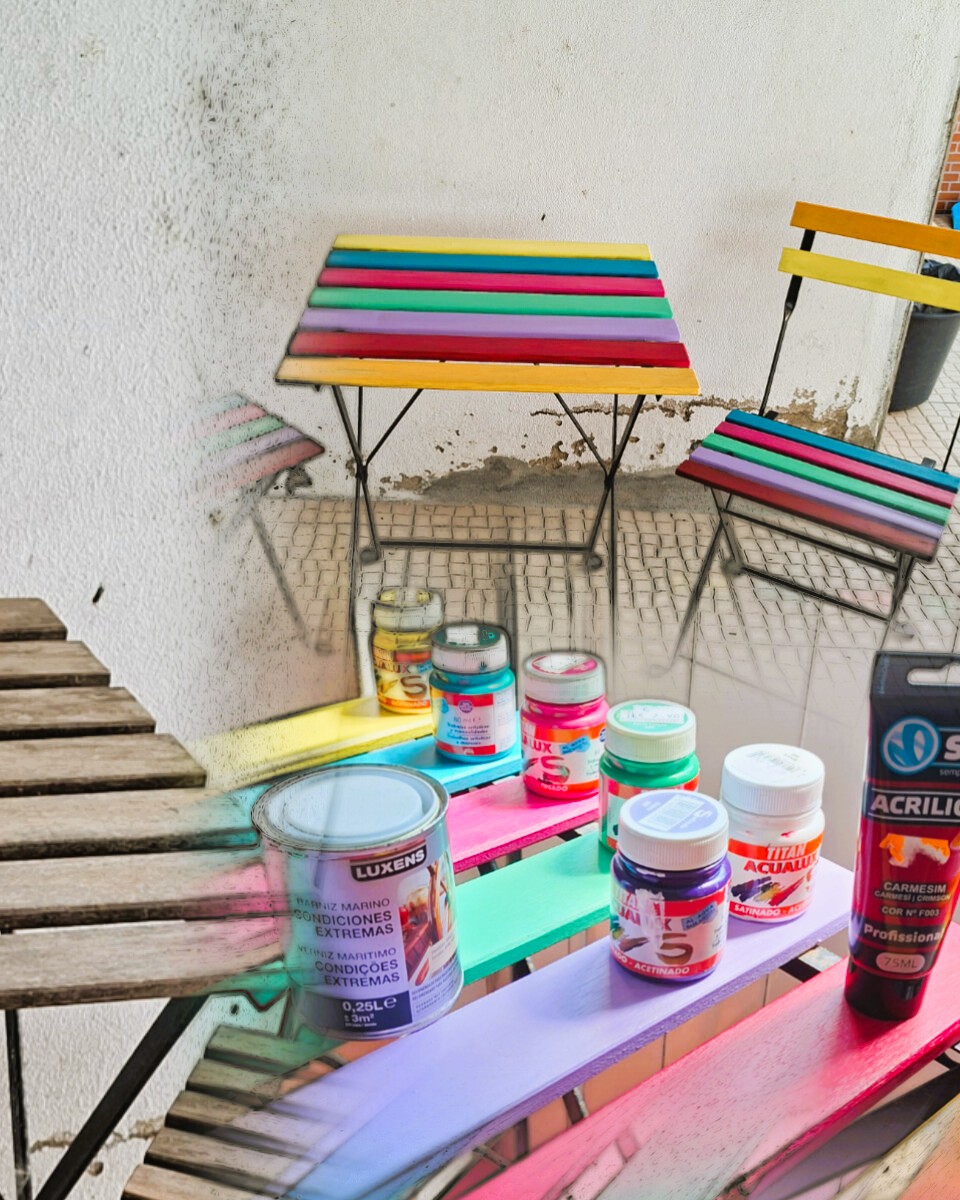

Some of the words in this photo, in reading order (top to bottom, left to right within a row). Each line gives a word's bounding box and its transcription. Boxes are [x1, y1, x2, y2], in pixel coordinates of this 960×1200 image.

[767, 844, 805, 860] TITAN
[356, 849, 426, 879] LUXENS
[883, 881, 947, 893] CARMESIM
[341, 898, 390, 911] MARINO
[734, 903, 780, 916] SATINADO
[881, 906, 904, 915] COR
[294, 909, 392, 926] CONDICIONES
[316, 923, 394, 939] EXTREMAS
[315, 958, 399, 976] CONDIÇÕES
[634, 962, 690, 977] ACETINADO
[884, 957, 918, 968] 75ML
[324, 972, 400, 987] EXTREMAS
